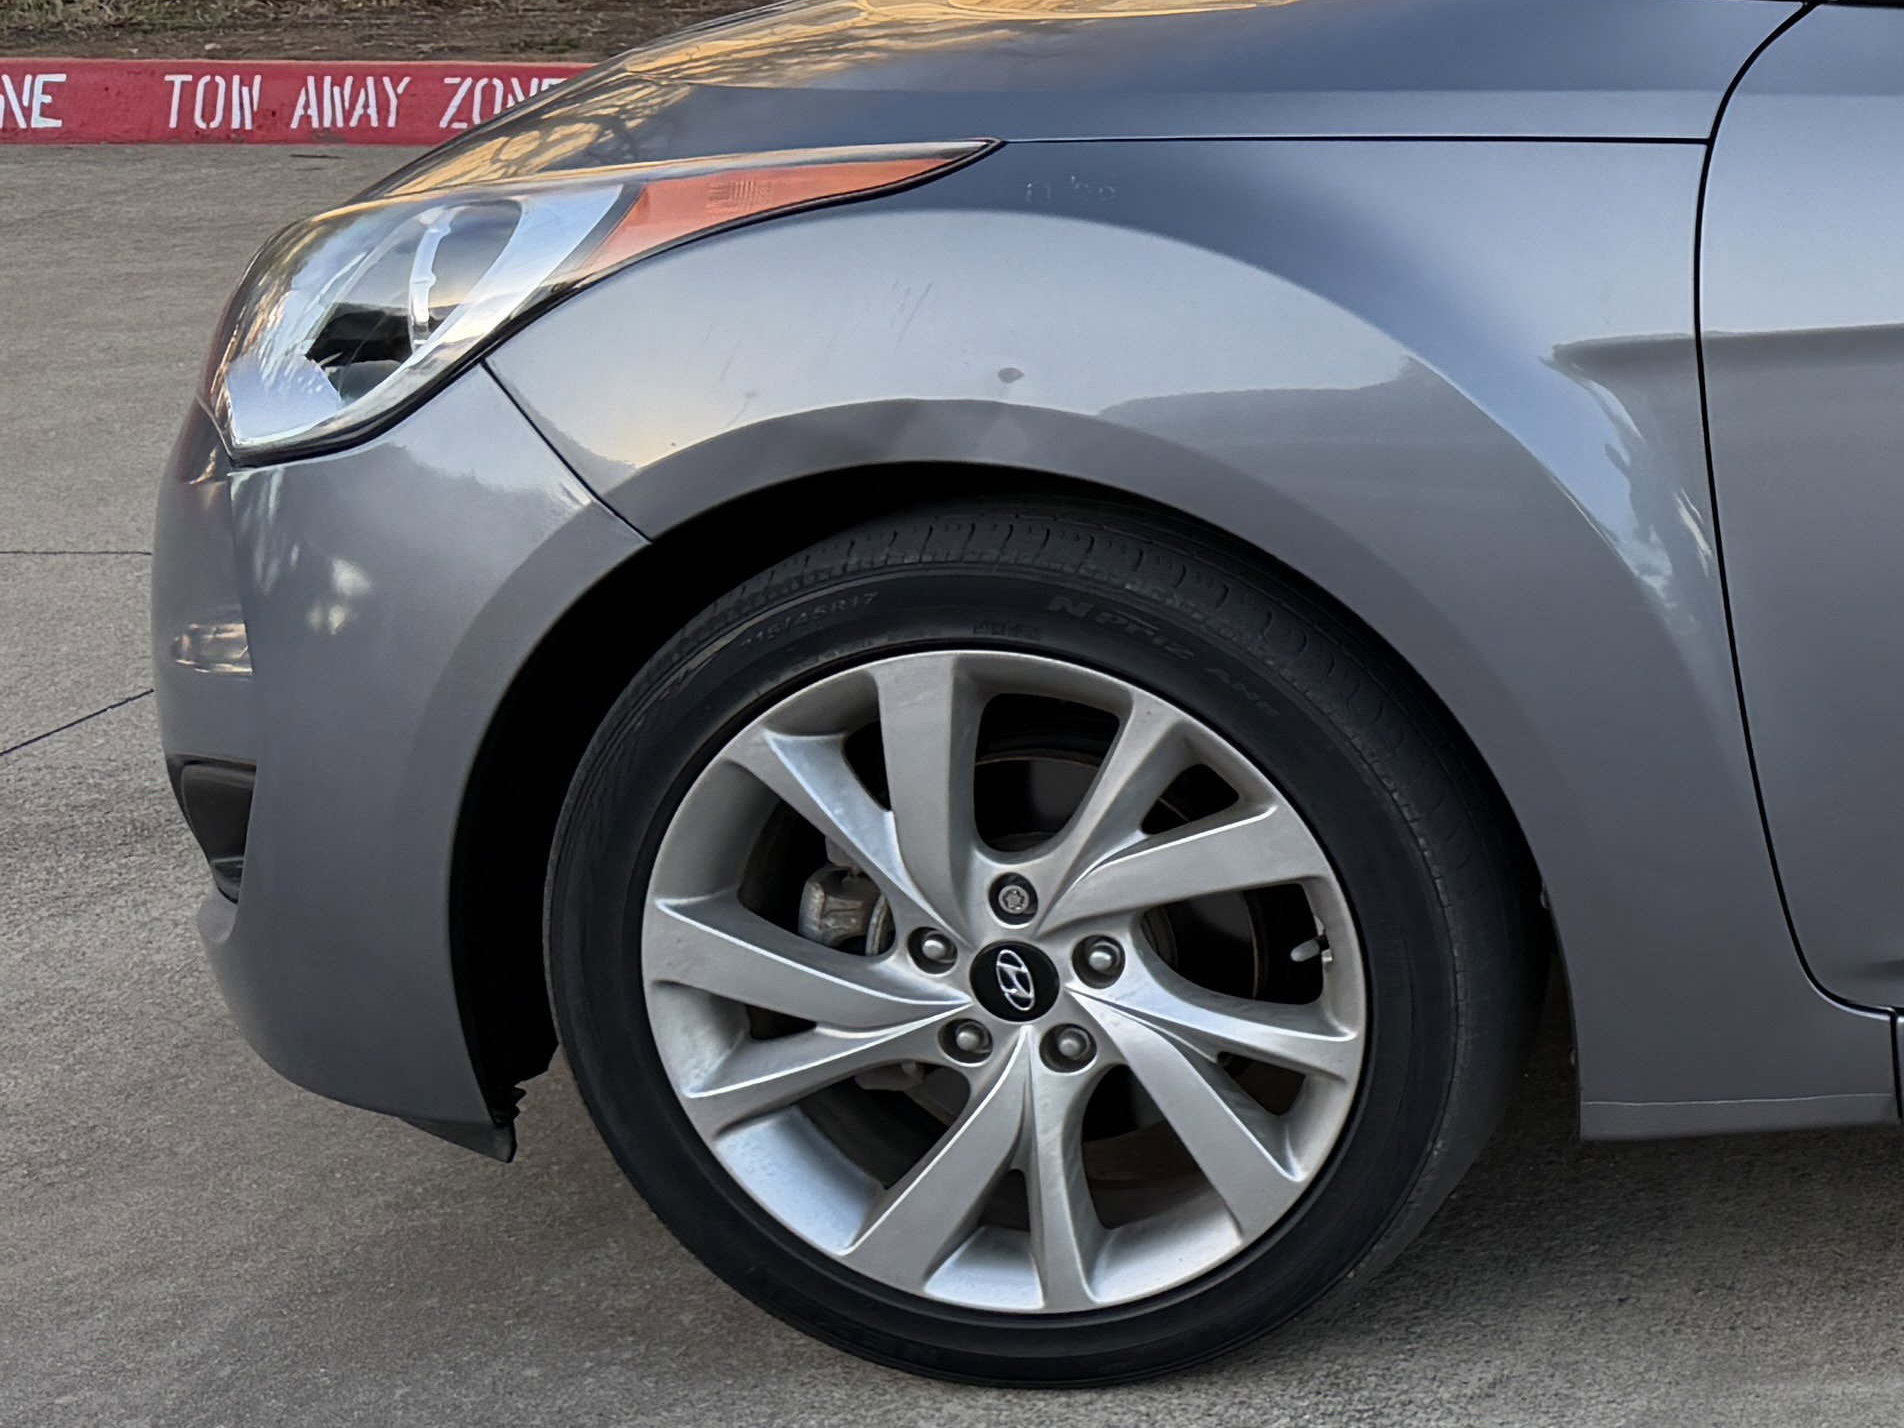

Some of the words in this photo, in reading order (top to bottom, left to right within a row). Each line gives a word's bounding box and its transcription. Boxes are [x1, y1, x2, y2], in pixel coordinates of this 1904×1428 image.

[164, 74, 262, 130] TOW
[291, 75, 411, 129] AWAY
[439, 77, 568, 129] ZON
